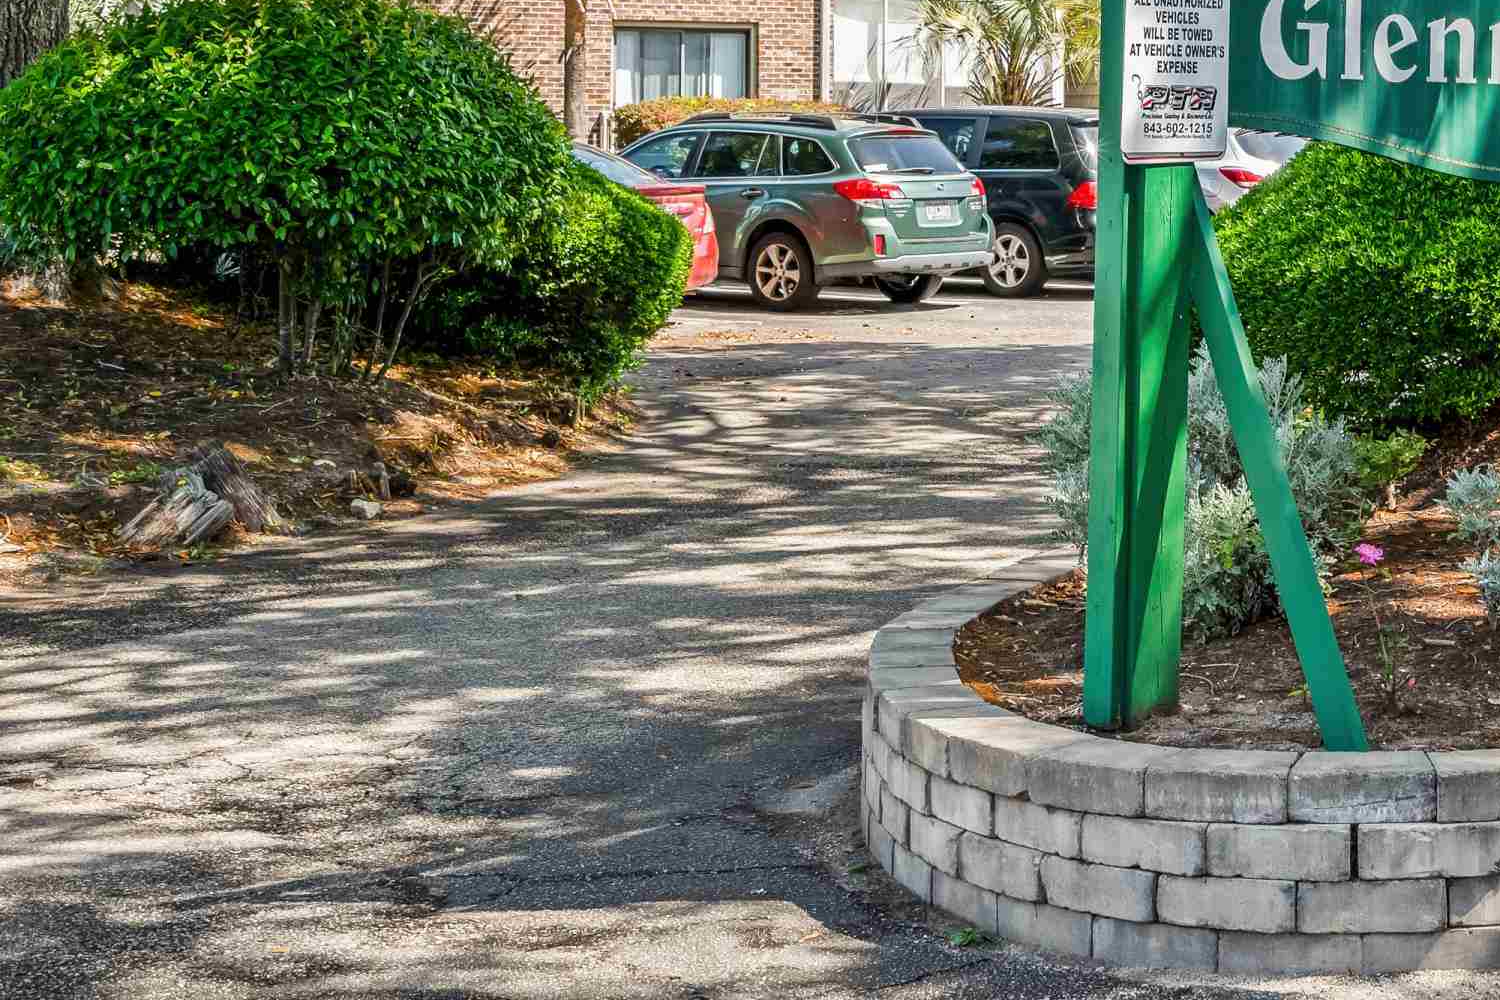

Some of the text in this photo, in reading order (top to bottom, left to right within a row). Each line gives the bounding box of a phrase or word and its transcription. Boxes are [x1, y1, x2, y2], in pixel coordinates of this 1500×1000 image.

[1155, 10, 1200, 25] VEHICLES
[1143, 26, 1213, 41] WILL BE TOWED
[1129, 43, 1225, 58] AT VEHICLE OWNER'S
[1157, 60, 1198, 74] EXPENSE
[1143, 122, 1213, 134] 843-602-1215
